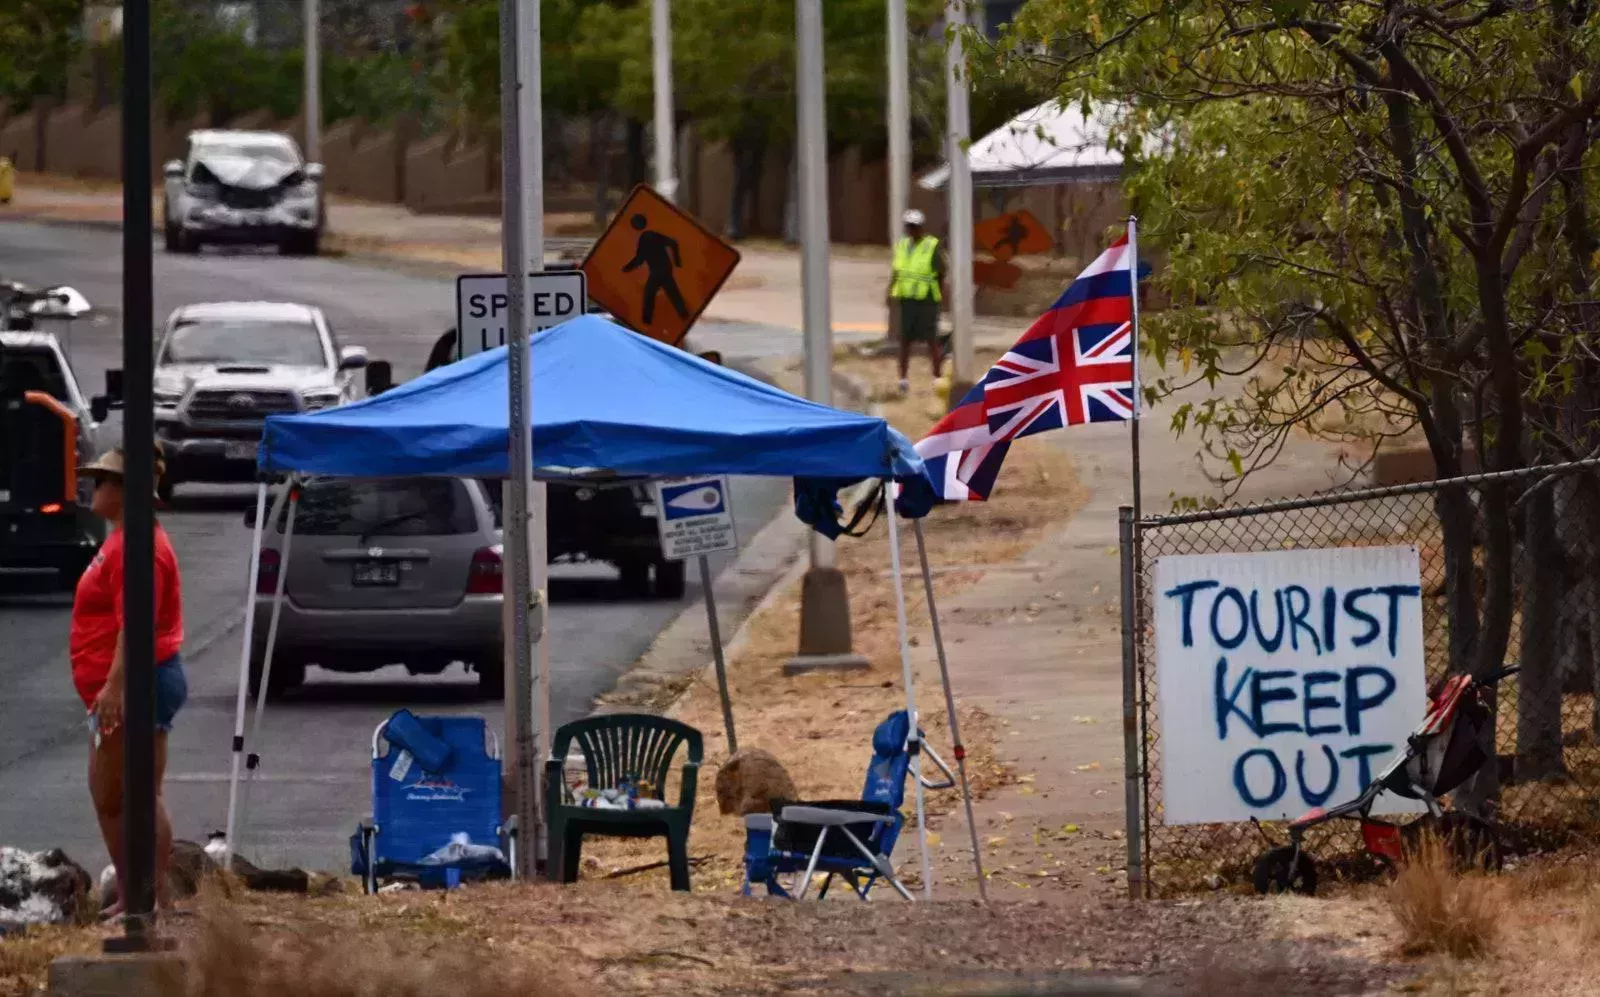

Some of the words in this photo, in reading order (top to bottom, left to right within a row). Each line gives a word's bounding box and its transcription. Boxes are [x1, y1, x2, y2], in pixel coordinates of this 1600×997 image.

[469, 292, 574, 318] SPED
[1164, 580, 1420, 657] TOURIST
[1215, 656, 1396, 740] KEEP
[1233, 744, 1394, 808] OUT
